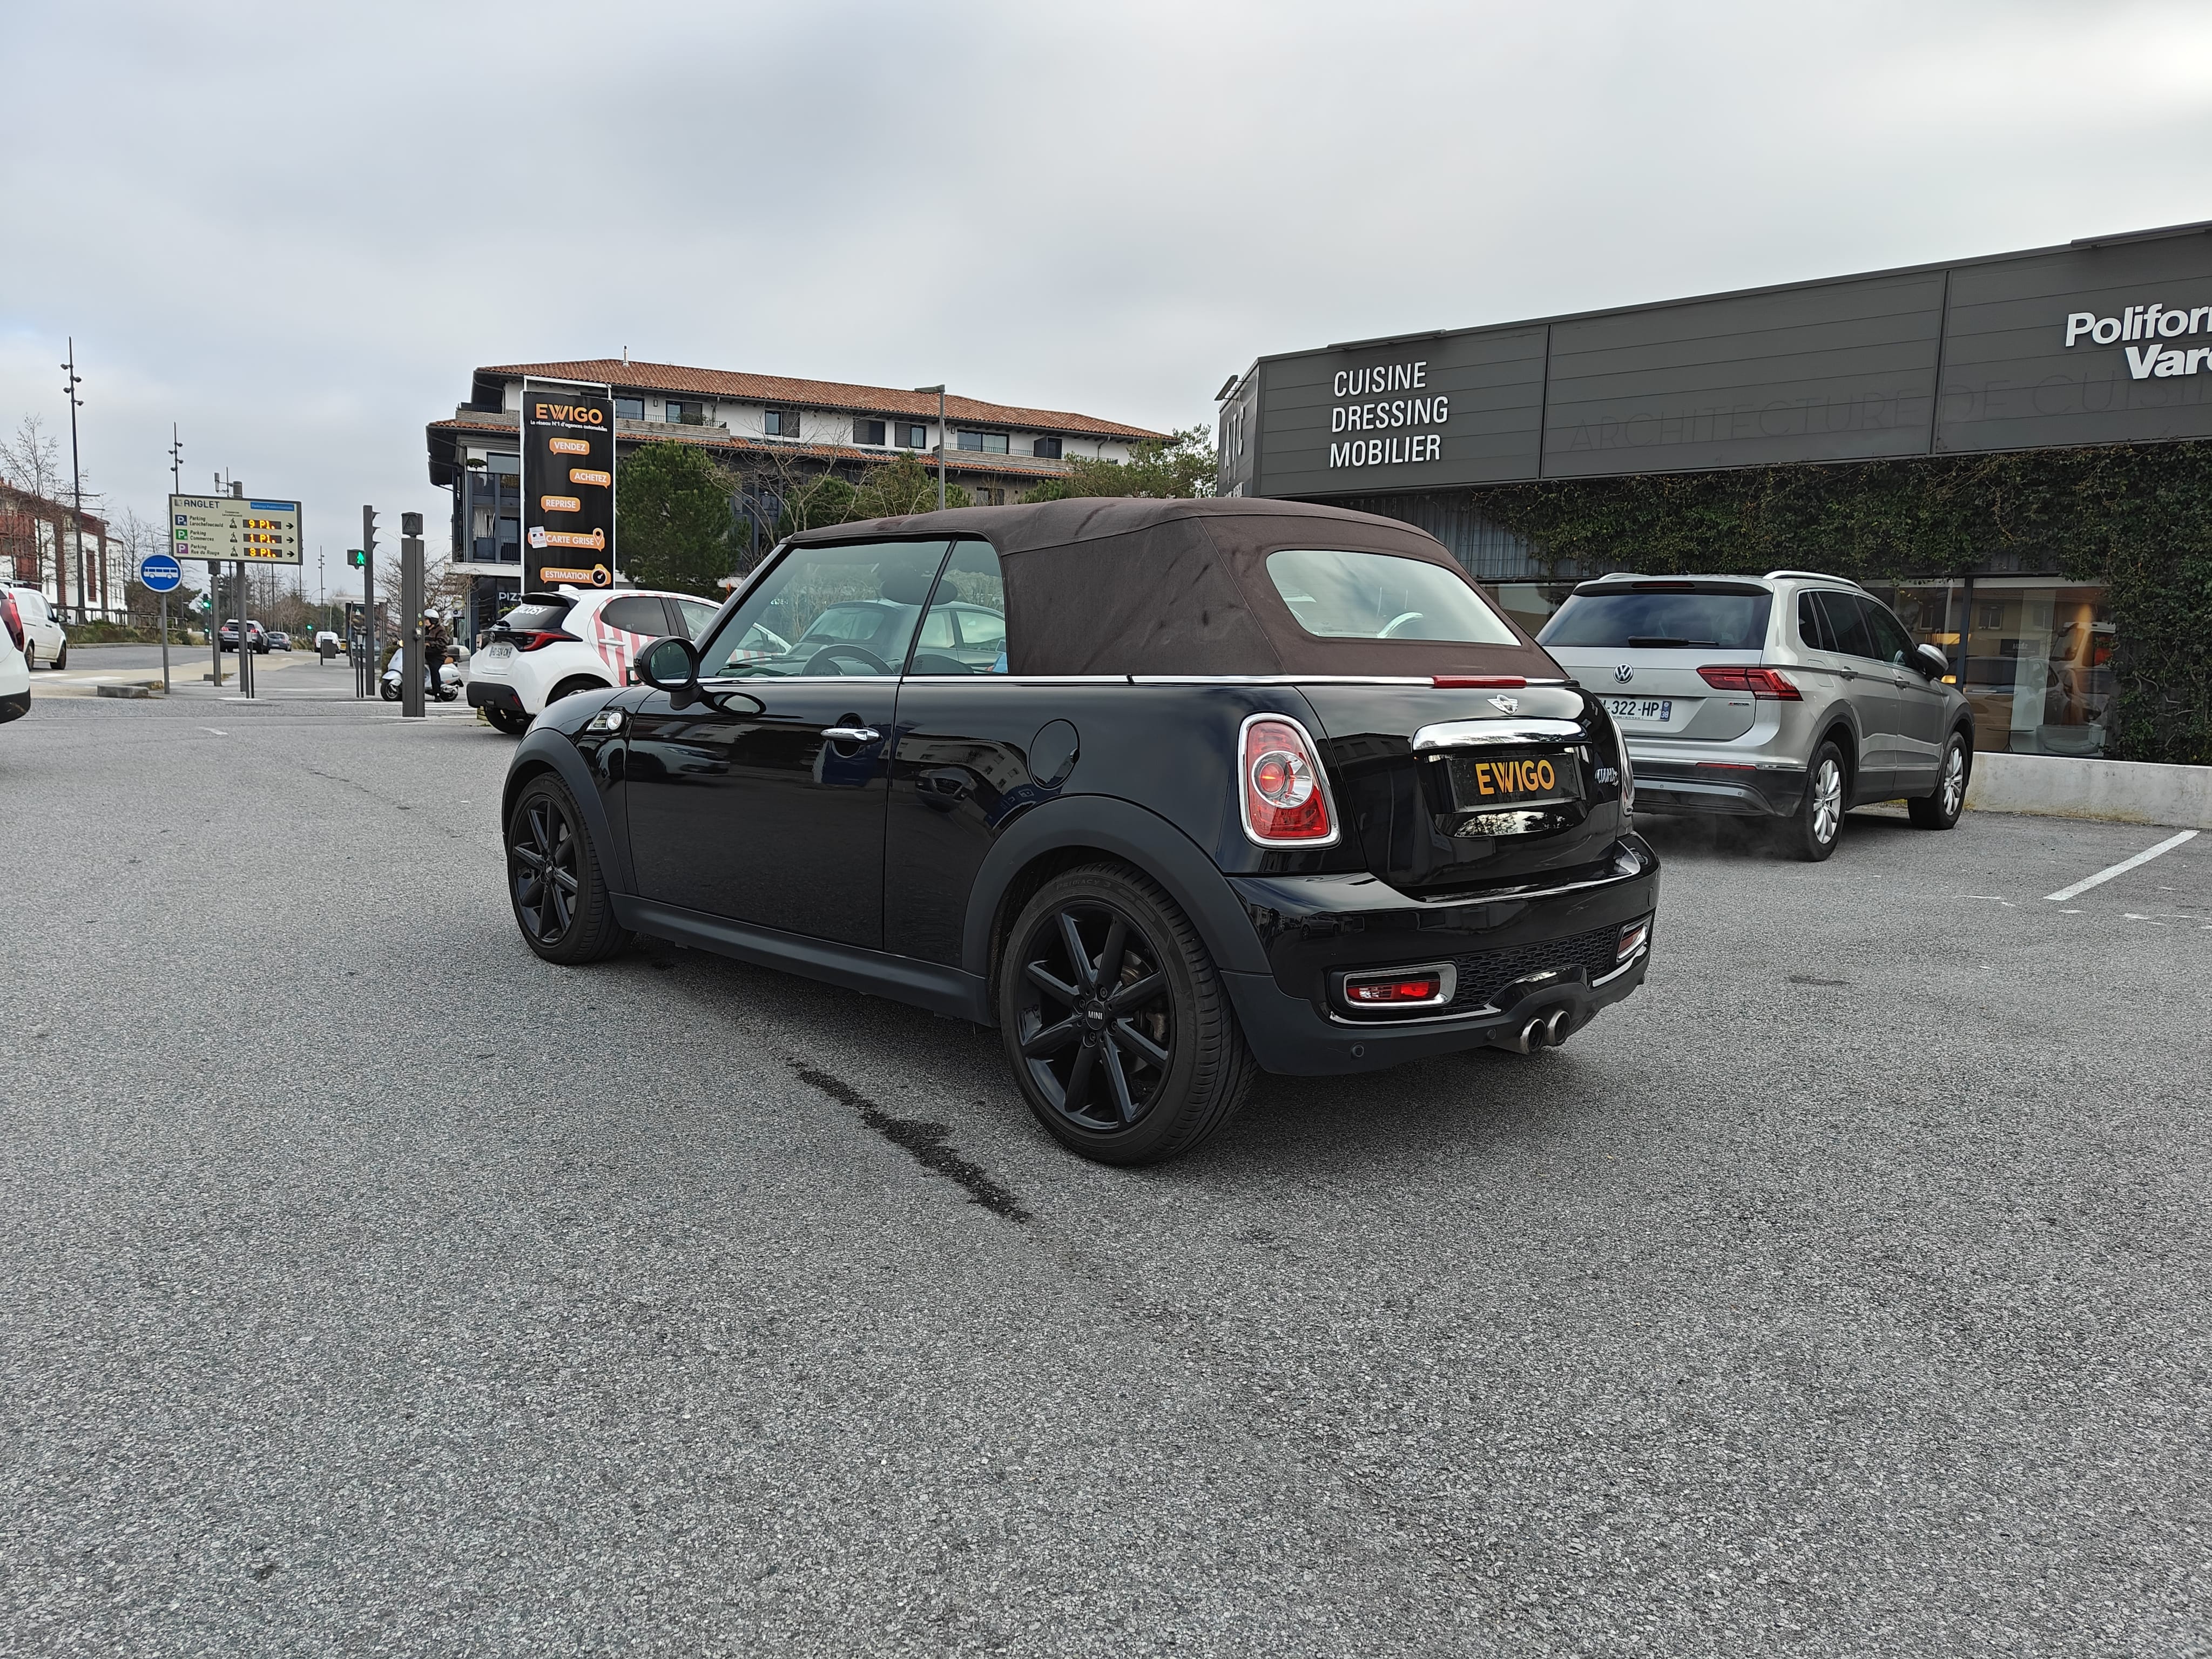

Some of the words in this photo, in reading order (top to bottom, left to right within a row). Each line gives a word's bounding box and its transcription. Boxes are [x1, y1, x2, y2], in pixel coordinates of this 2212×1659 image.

[2065, 303, 2212, 347] Polifor
[2125, 343, 2212, 380] Var
[1334, 361, 1427, 397] CUISINE
[535, 403, 603, 424] EWIGO
[1332, 396, 1449, 433] DRESSING
[554, 441, 586, 451] VENDEZ
[1330, 434, 1441, 468] MOBILIER
[574, 472, 607, 483] ACHETEZ
[184, 499, 220, 509] ANGLET
[545, 499, 576, 509] REPRISE
[248, 520, 255, 529] 9
[250, 534, 255, 543] 1
[546, 535, 570, 544] CARTE
[572, 536, 595, 545] GRISE
[545, 570, 590, 581] ESTIMATION
[1603, 700, 1660, 717] -322-HP
[1475, 760, 1555, 795] EWIGO
[1056, 878, 1100, 891] PRIMACY
[1088, 1010, 1103, 1020] MINI
